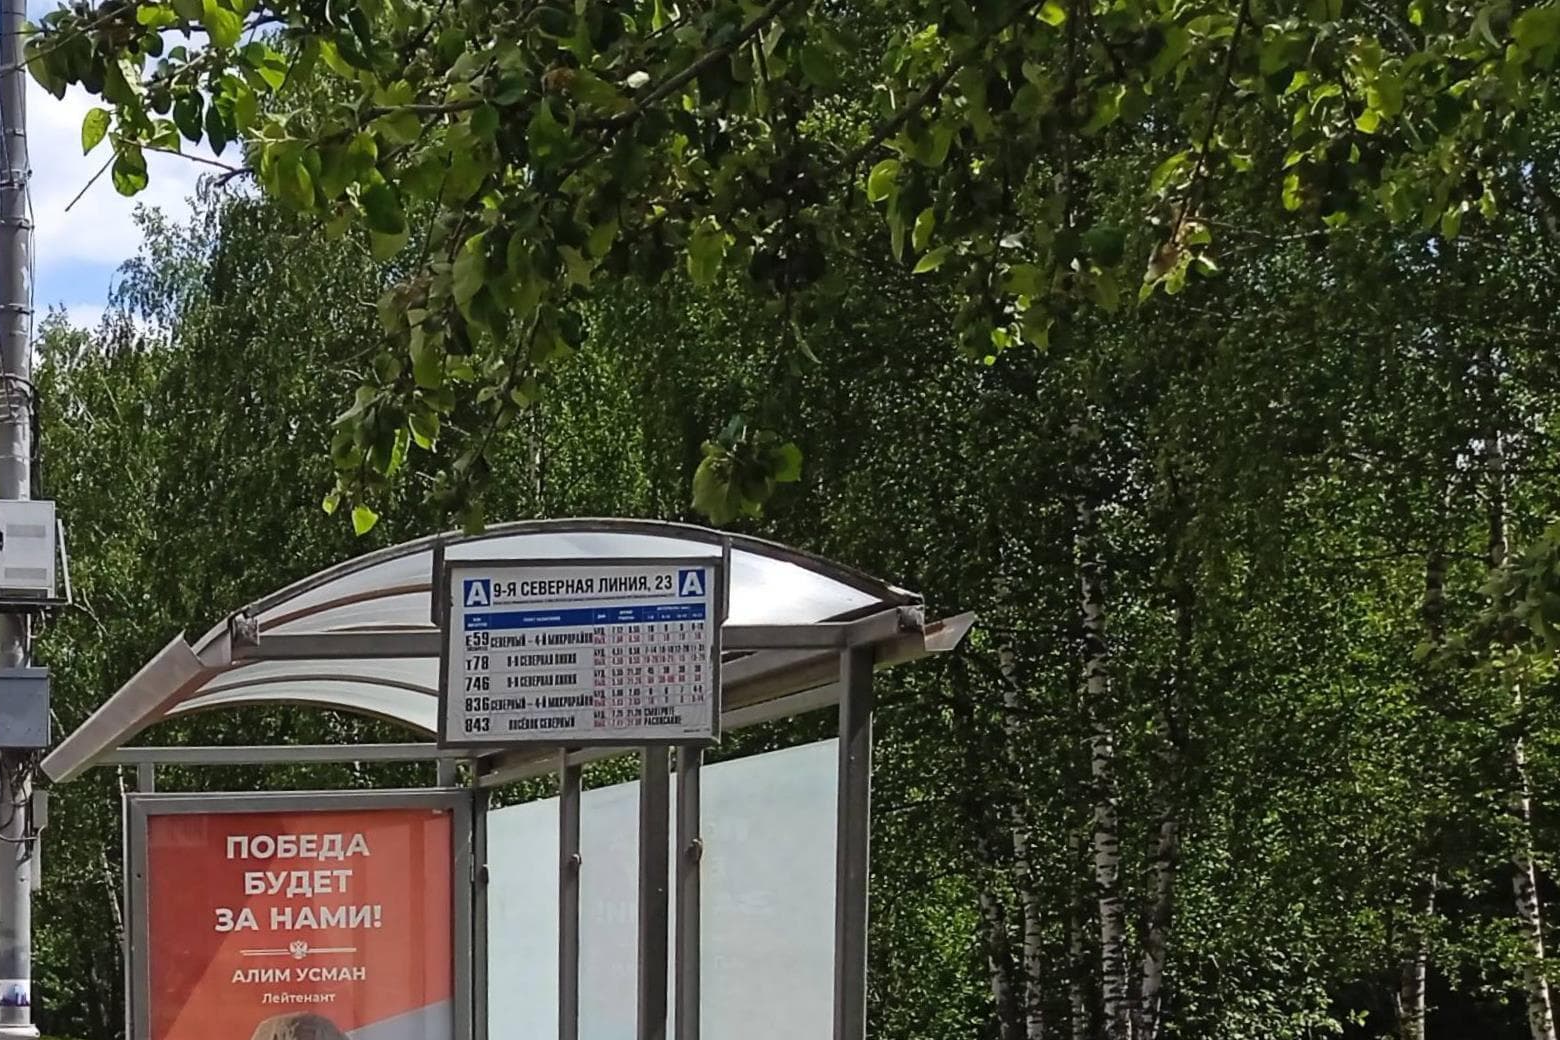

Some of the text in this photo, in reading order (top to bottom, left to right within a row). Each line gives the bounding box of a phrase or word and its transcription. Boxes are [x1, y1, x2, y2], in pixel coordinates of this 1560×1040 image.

[493, 583, 516, 598] 9-Я
[521, 577, 594, 596] СЕВЕРНАЯ
[598, 577, 651, 594] ЛИНИЯ,
[655, 575, 673, 591] 23
[465, 676, 490, 691] 746
[465, 697, 490, 712] 836
[465, 718, 490, 733] 843
[226, 834, 369, 860] ПОБЕДА
[244, 869, 352, 897] БУДЕТ
[214, 904, 382, 933] ЗА НАМИ!
[231, 966, 367, 984] АЛИМ УСМАН
[261, 991, 335, 1005] Лейтенант
